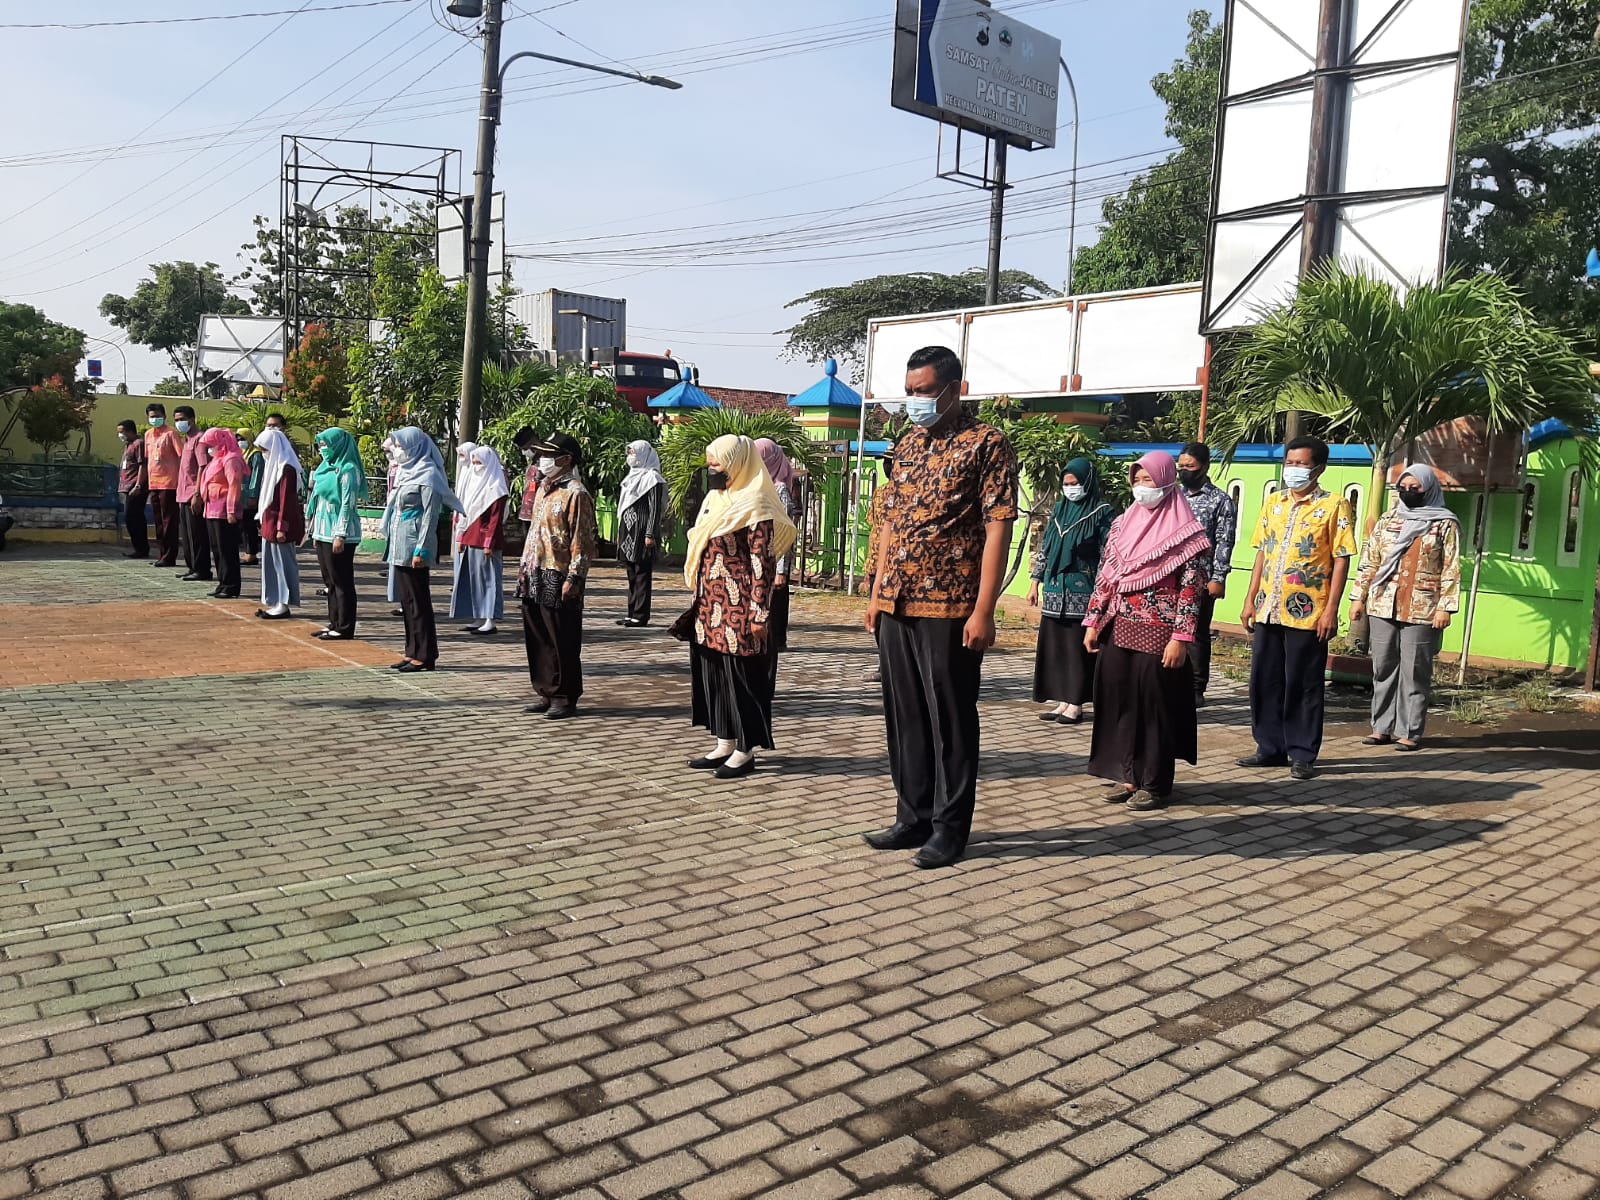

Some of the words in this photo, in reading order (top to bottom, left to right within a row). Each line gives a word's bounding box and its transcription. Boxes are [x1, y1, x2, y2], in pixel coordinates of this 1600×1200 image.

[945, 43, 989, 73] SAMSAT
[1019, 74, 1057, 100] JATENG
[976, 76, 1027, 116] PATEN
